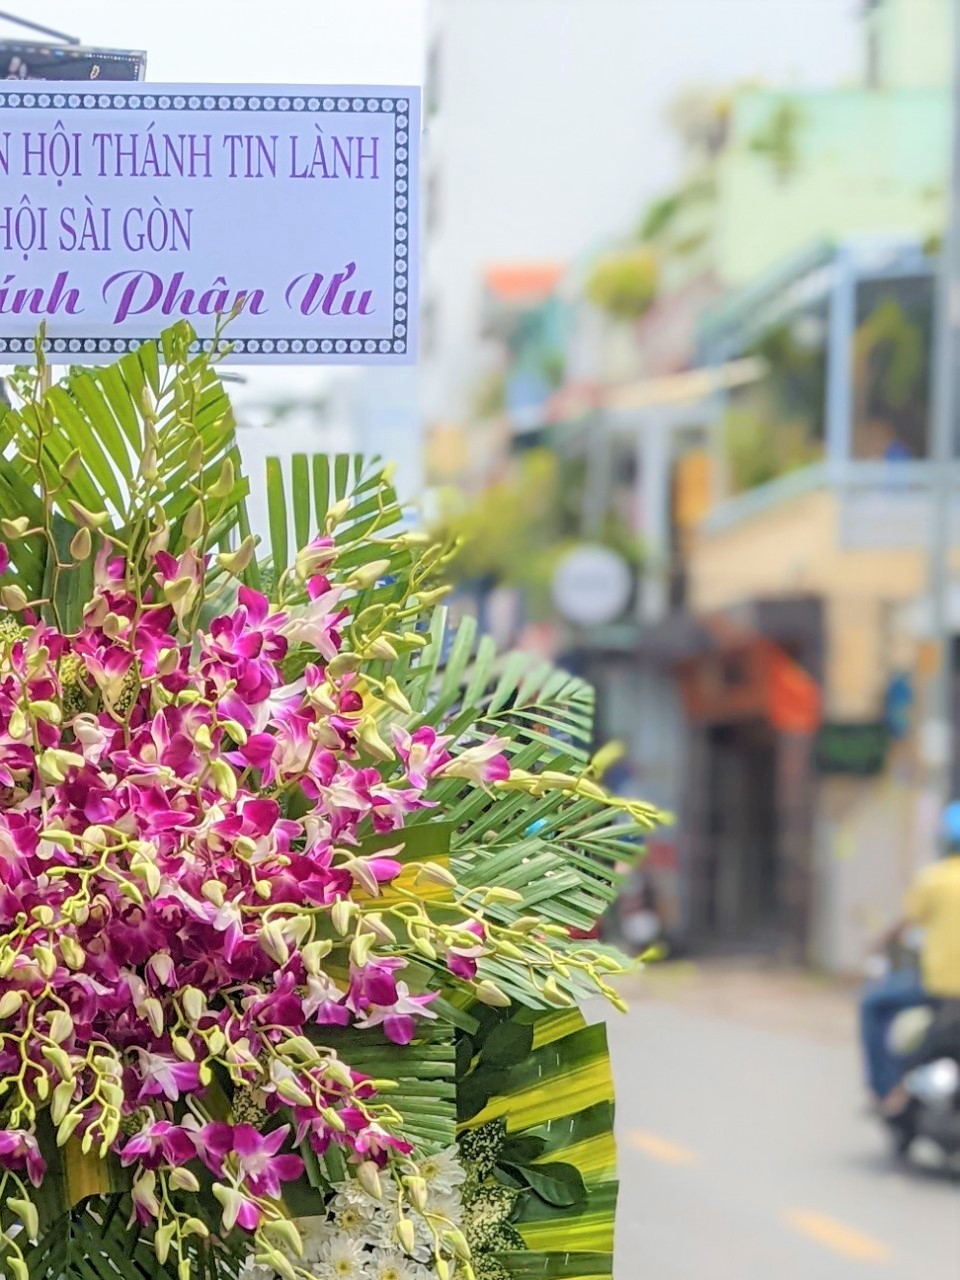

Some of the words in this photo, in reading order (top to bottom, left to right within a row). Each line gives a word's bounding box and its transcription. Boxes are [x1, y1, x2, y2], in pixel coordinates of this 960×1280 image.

[22, 119, 82, 187] HỘI
[92, 121, 212, 178] THÁNH
[223, 134, 279, 178] TIN
[289, 123, 380, 179] LÀNH
[58, 195, 112, 252] SÀI
[123, 195, 194, 252] GÒN
[102, 269, 269, 325] Phân
[285, 261, 376, 316] Ưu
